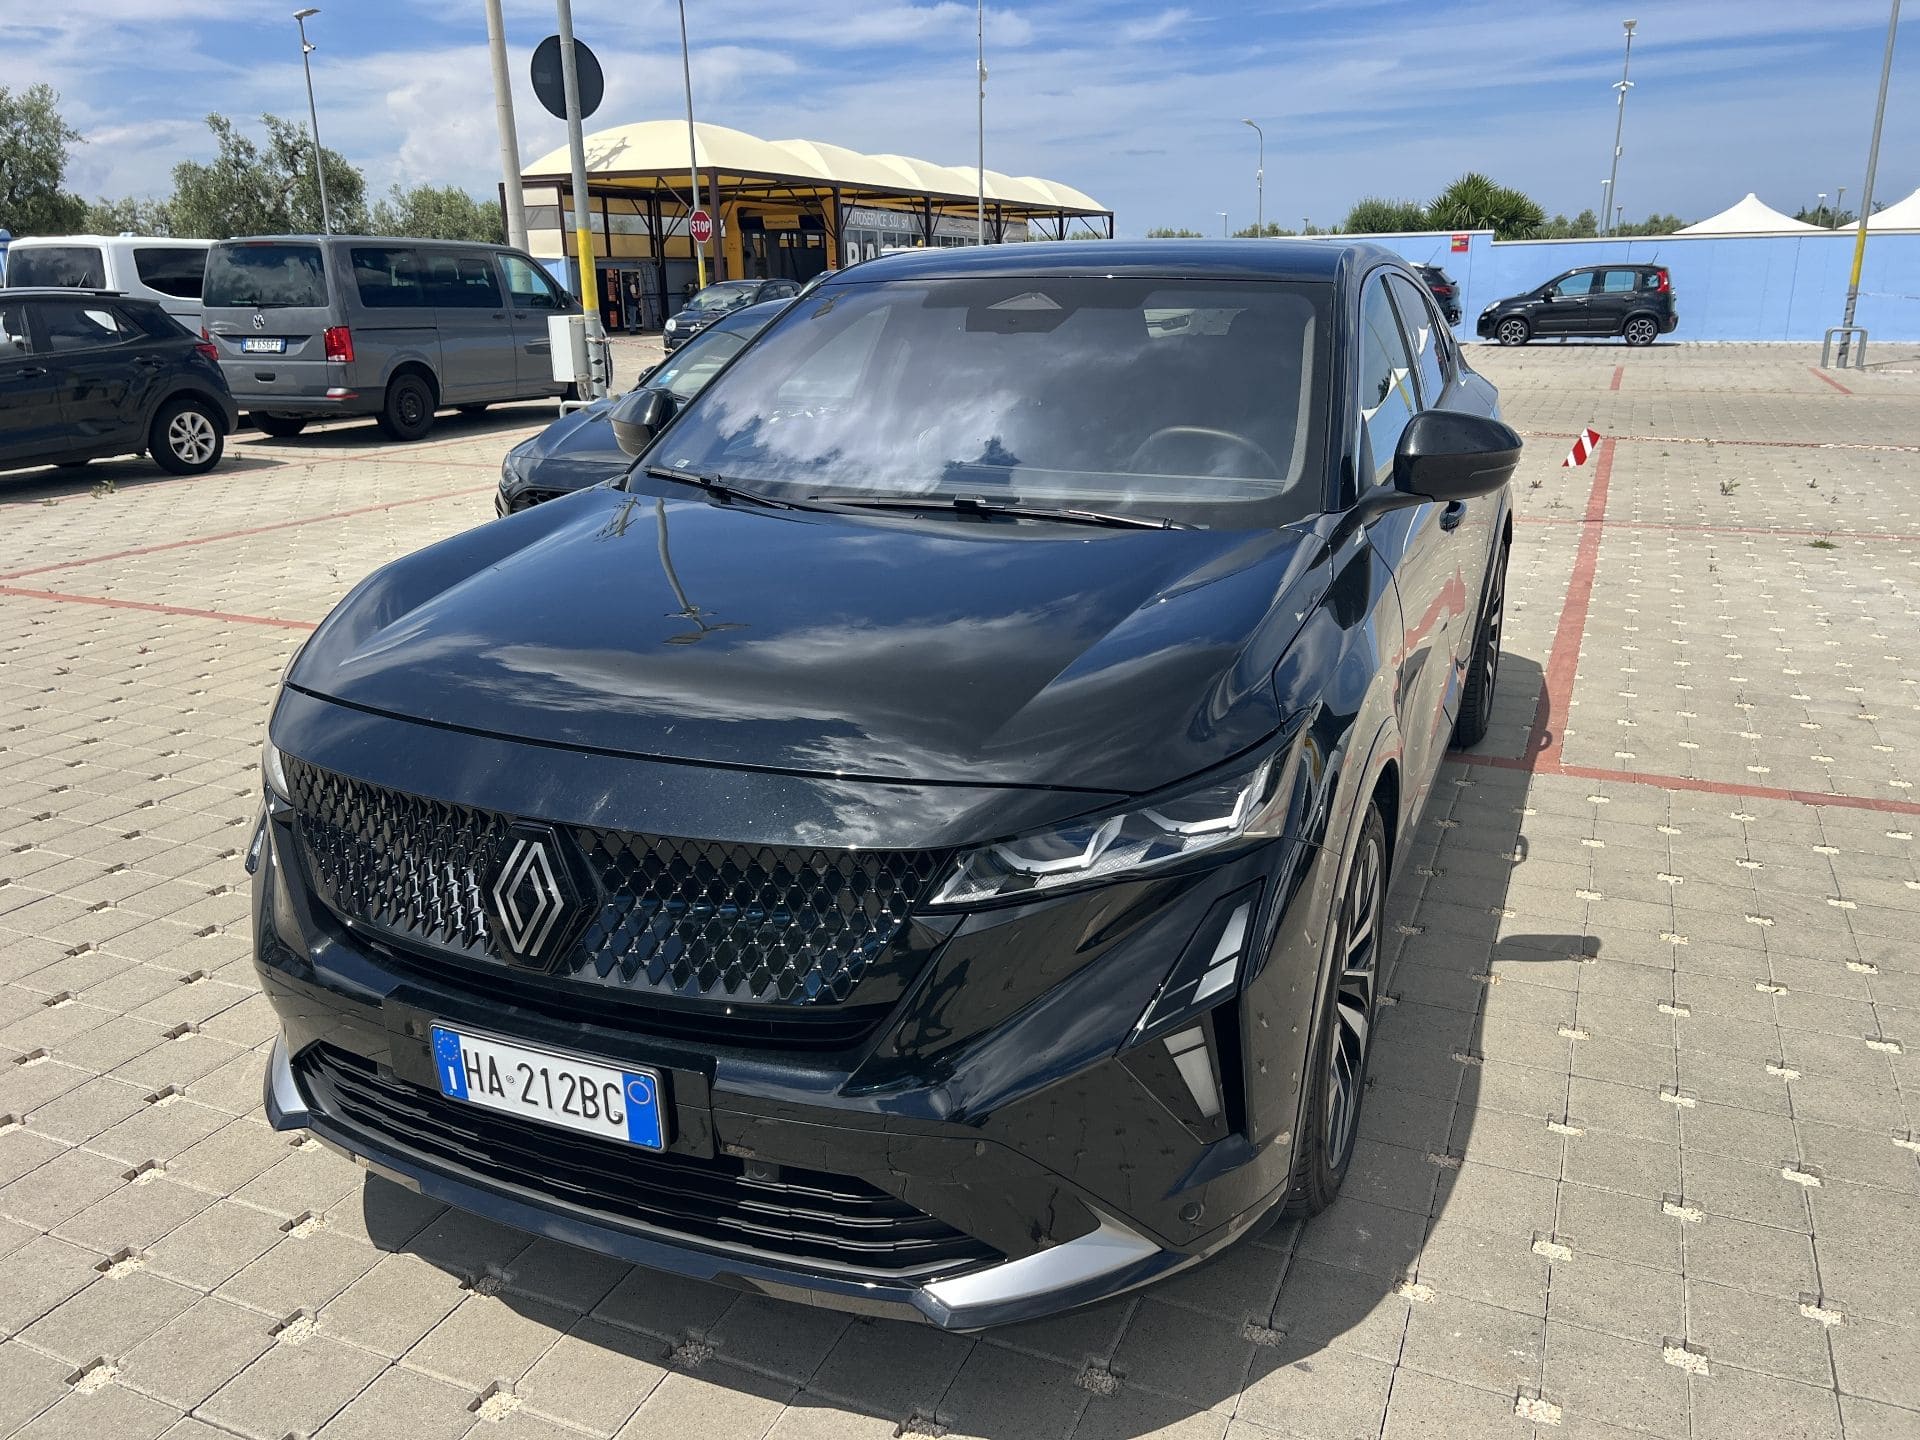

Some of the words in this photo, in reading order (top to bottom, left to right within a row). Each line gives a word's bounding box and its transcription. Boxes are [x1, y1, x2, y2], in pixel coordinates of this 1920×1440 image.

[847, 211, 887, 226] AUTOSERVICE
[691, 220, 710, 233] STOP
[462, 1048, 505, 1098] HA
[516, 1062, 624, 1126] 212BG
